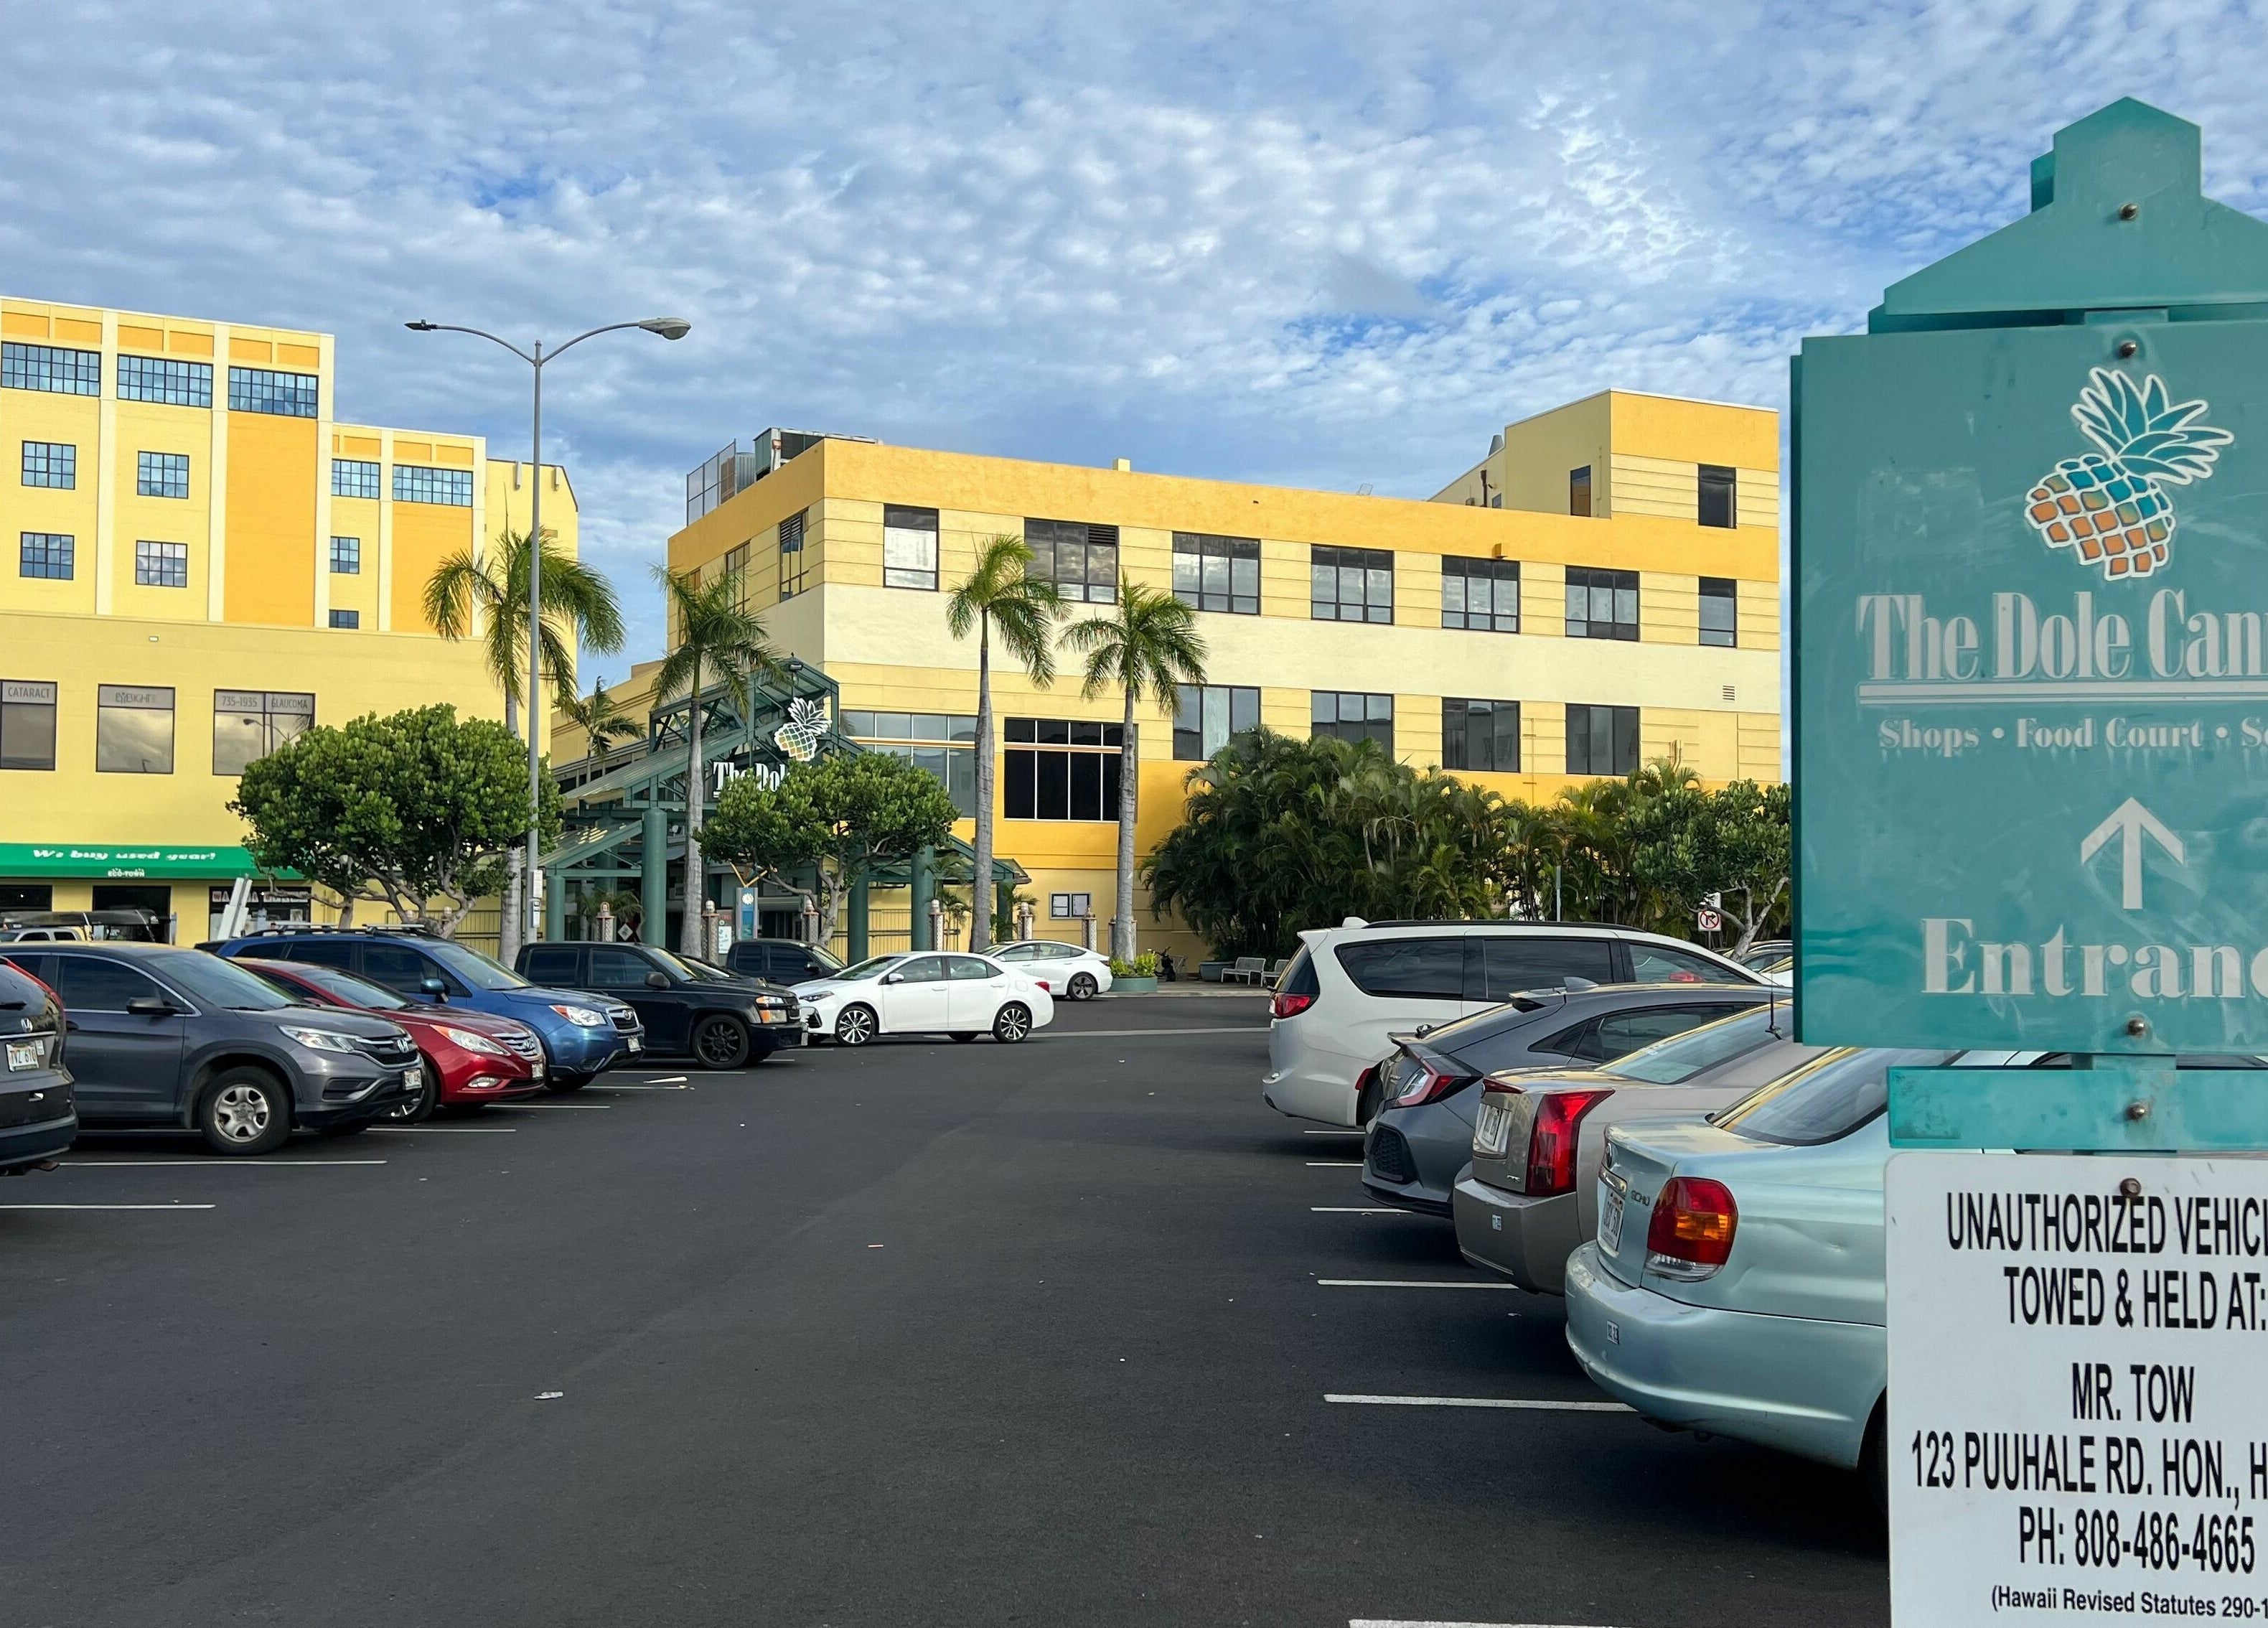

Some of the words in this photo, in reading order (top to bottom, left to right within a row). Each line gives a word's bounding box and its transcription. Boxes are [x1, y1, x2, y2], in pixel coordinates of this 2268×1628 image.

[1857, 594, 1979, 680] The
[1993, 591, 2131, 678] Dole
[2149, 589, 2268, 678] Can
[8, 686, 51, 698] CATARACT
[271, 697, 308, 709] GLAUCOMA
[1880, 718, 1979, 757] Shops
[2017, 718, 2094, 747] Food
[2106, 717, 2203, 747] Court
[2241, 717, 2268, 747] S
[755, 763, 789, 792] Dol
[33, 849, 64, 858] We
[70, 850, 108, 860] buy
[166, 852, 216, 861] gear!
[1946, 1192, 2165, 1253] UNAUTHORIZED
[2004, 1266, 2104, 1326] TOWED
[2115, 1268, 2134, 1328] &
[2143, 1270, 2218, 1330] HELD
[2226, 1271, 2267, 1331] AT:
[2071, 1362, 2122, 1421] MR.
[2130, 1364, 2195, 1423] TOW
[1912, 1431, 1956, 1488] 123
[1964, 1431, 2096, 1494] PUUHALE
[2106, 1436, 2152, 1496] RD.
[2162, 1438, 2239, 1510] HON.,
[2019, 1506, 2065, 1565] PH:
[2075, 1508, 2255, 1574] 808-486-4665
[1992, 1585, 2057, 1612] (Hawaii
[2063, 1589, 2135, 1614] Revised
[2141, 1591, 2216, 1617] Statutes
